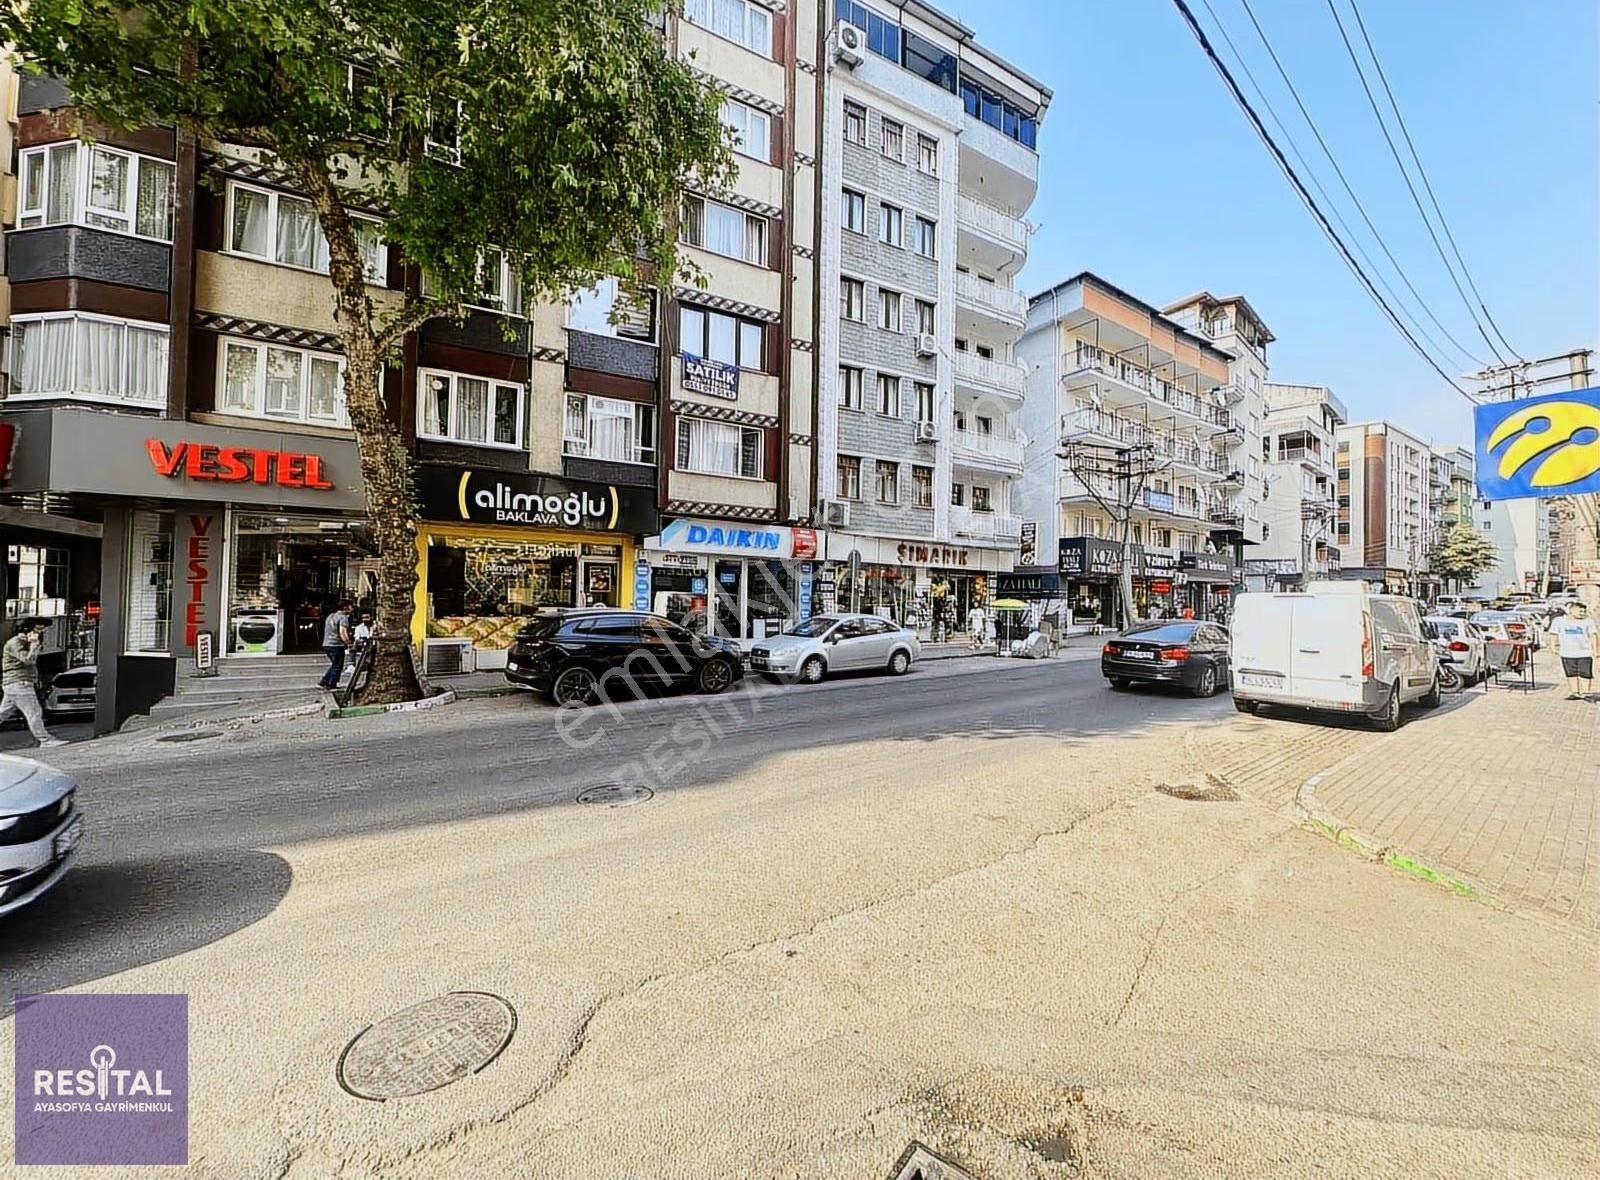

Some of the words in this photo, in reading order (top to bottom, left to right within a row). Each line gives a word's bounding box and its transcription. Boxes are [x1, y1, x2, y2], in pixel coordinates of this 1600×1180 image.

[686, 362, 735, 385] SATILIK
[145, 438, 334, 490] VESTEL
[475, 483, 606, 526] alimoğlu
[496, 510, 559, 525] BAKLAVA
[686, 525, 780, 551] DAIKIN
[1092, 548, 1117, 563] KOZA
